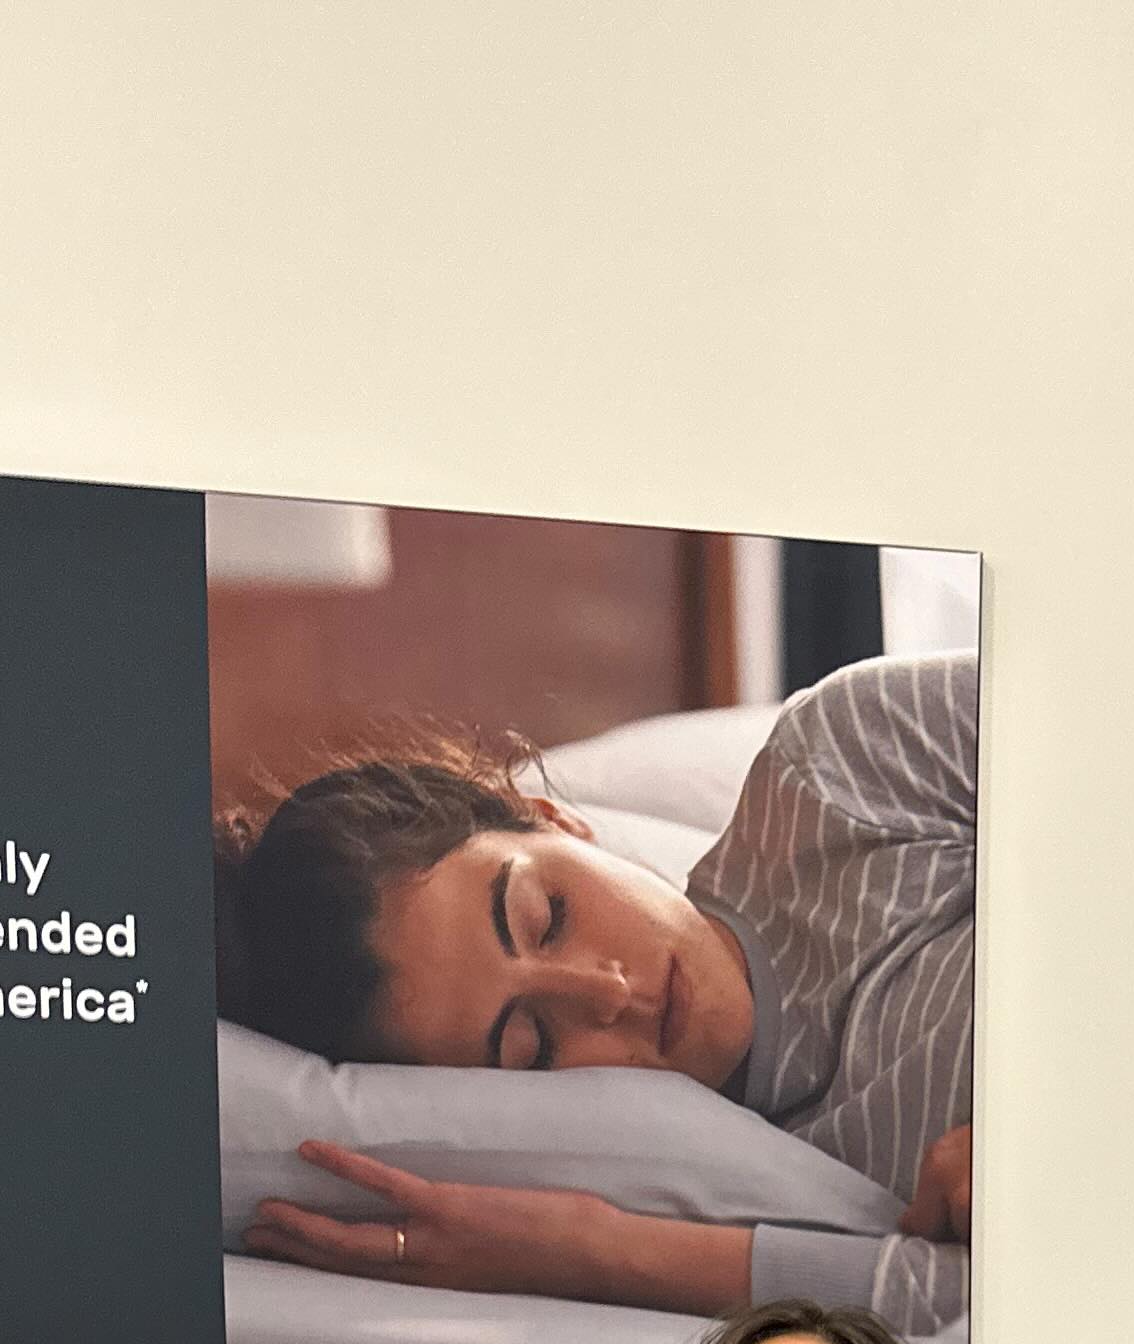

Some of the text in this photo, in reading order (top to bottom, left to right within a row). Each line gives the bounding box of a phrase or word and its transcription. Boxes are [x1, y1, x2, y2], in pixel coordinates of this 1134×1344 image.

[0, 840, 51, 896] ly
[0, 910, 137, 958] nded
[0, 977, 149, 1024] erica
